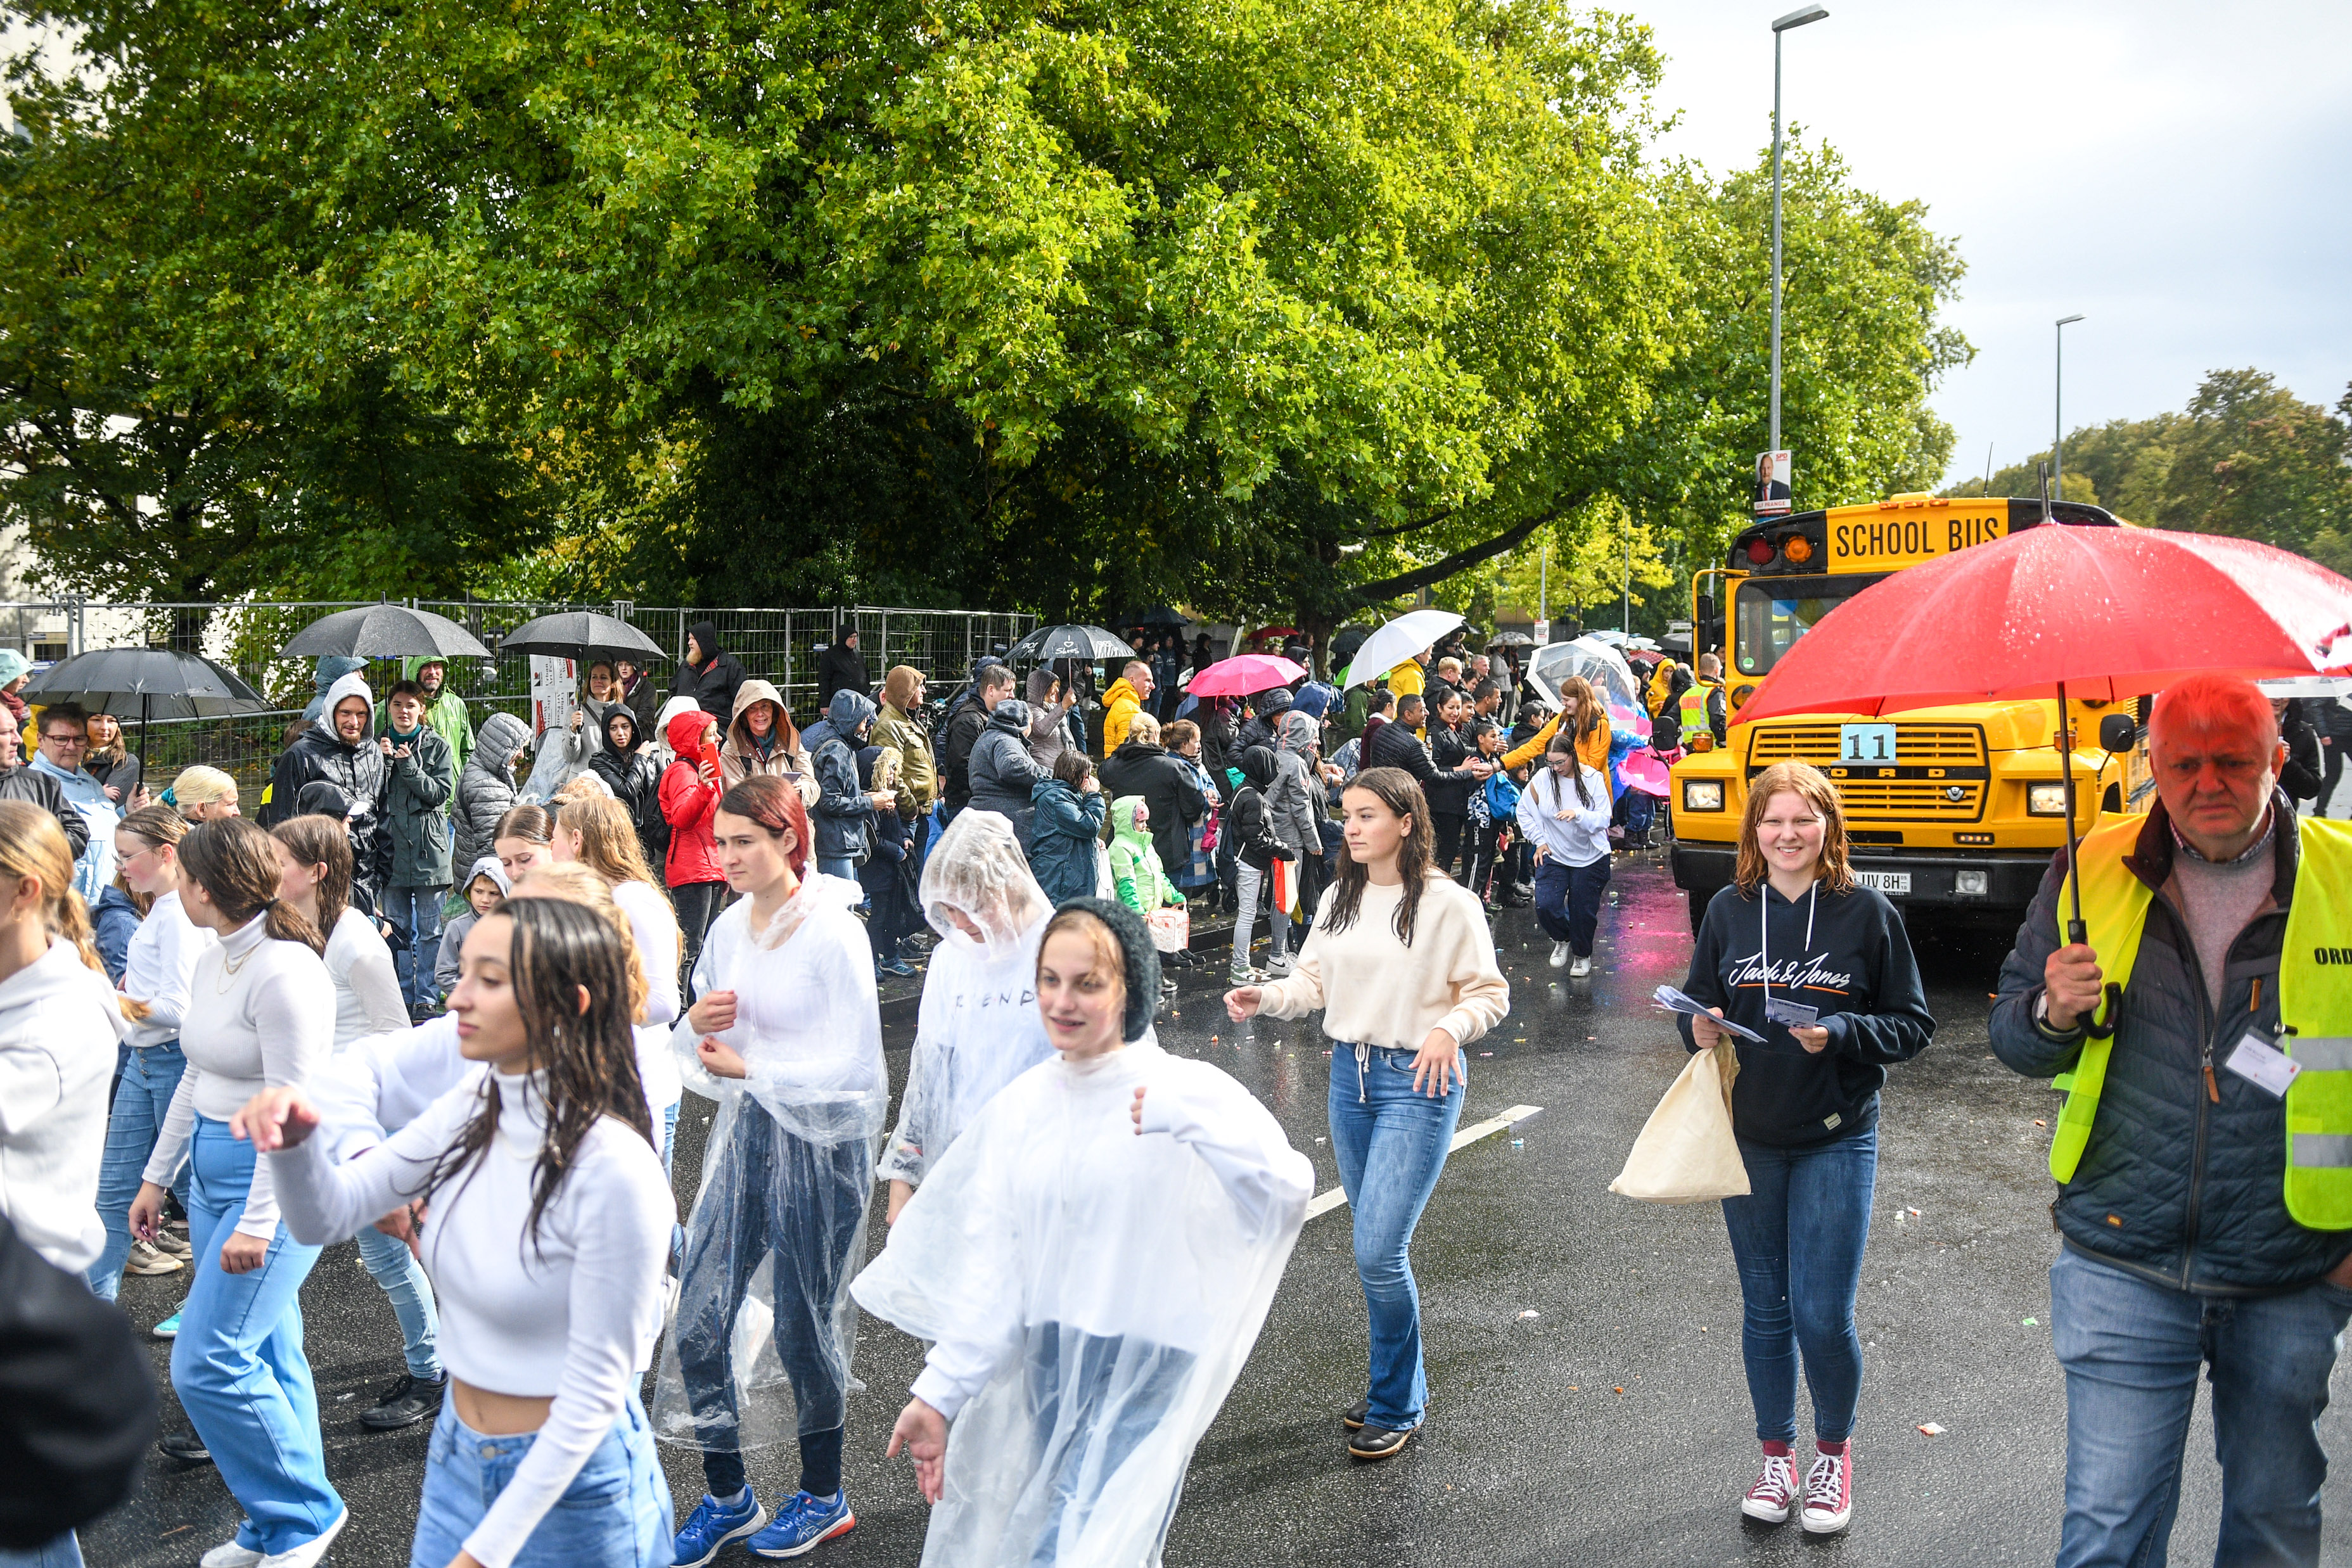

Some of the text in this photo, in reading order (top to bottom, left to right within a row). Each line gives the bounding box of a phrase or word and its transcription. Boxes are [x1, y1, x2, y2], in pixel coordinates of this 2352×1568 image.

[1836, 517, 1998, 557] SCHOOL BUS
[1848, 734, 1889, 760] 11
[1831, 768, 1946, 778] ORD
[1883, 875, 1900, 889] 8H
